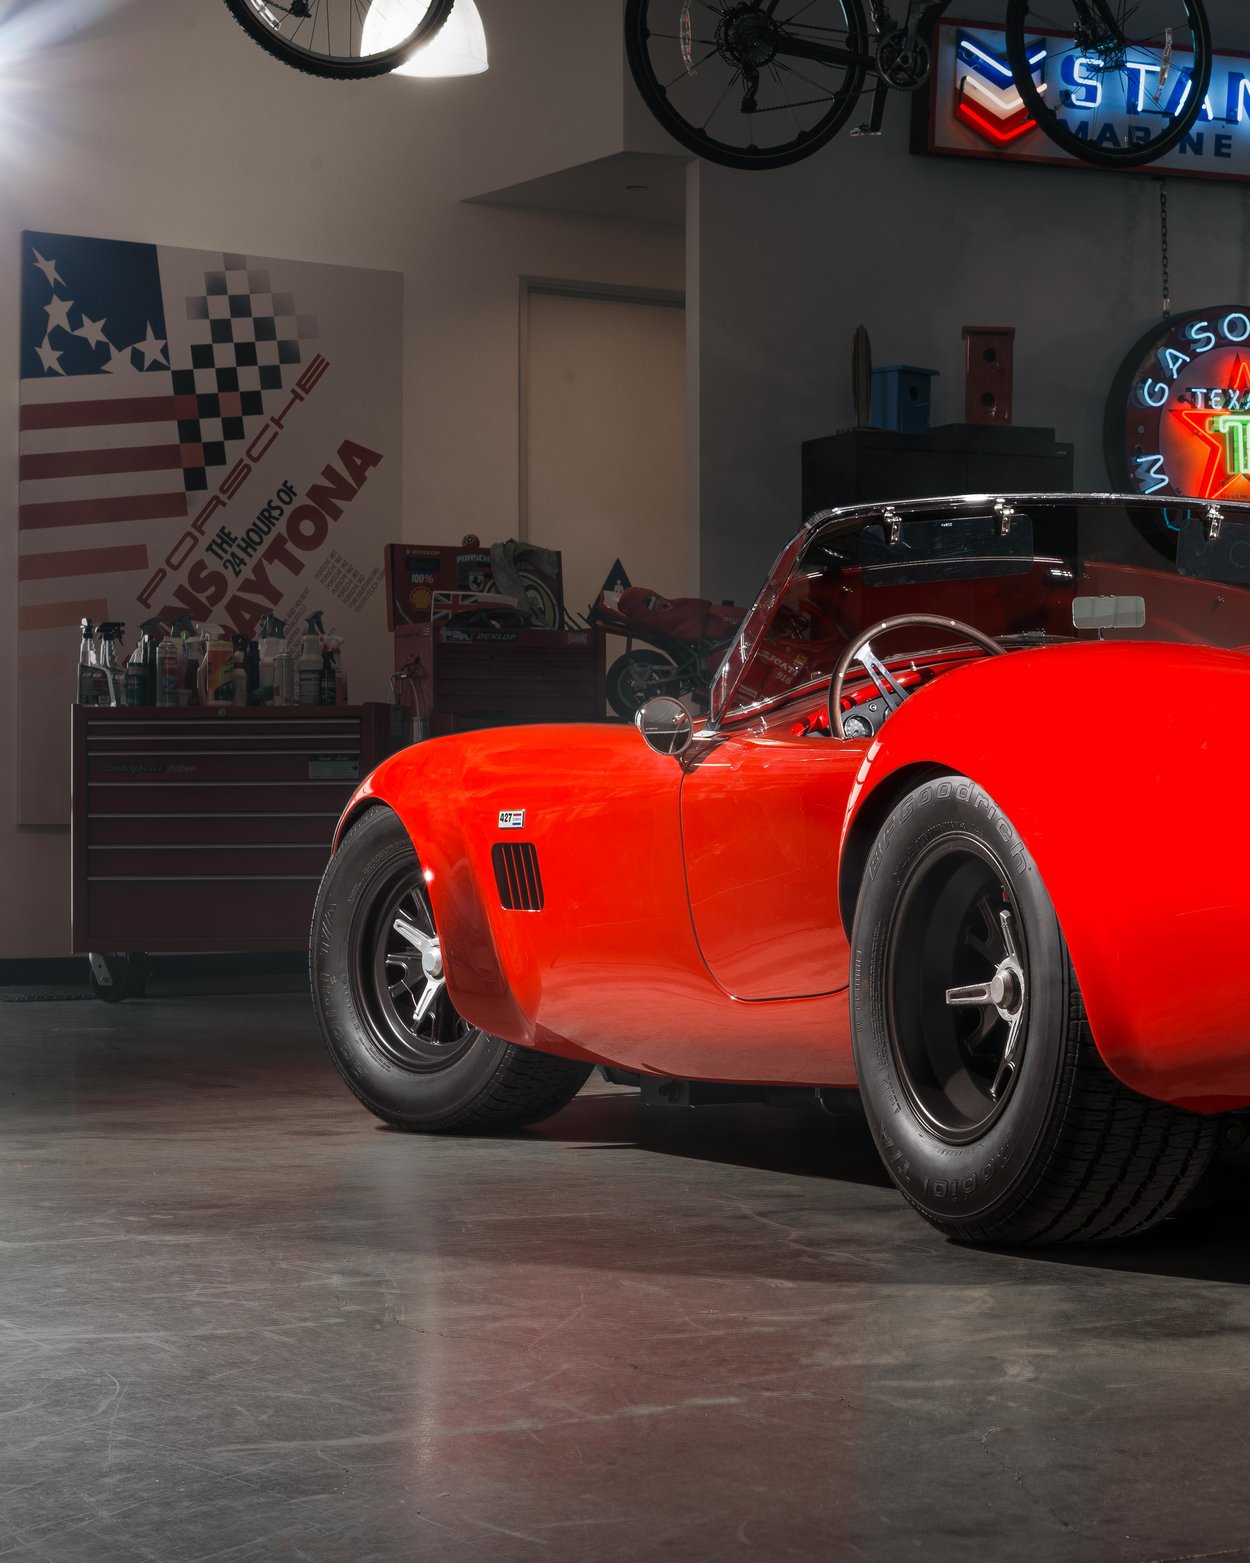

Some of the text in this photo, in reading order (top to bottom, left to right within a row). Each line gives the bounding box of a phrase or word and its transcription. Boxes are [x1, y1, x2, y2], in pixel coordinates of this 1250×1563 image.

[1057, 118, 1233, 159] MARNE
[135, 353, 330, 609] PORSCHE
[205, 525, 238, 563] THE
[222, 439, 385, 642] AYTONA
[223, 480, 298, 578] 24 HOURS OF
[411, 573, 434, 584] 100%
[476, 632, 518, 642] DUNLOP
[775, 671, 793, 685] 916
[499, 813, 512, 823] 427
[870, 781, 1029, 882] BFGoodrich
